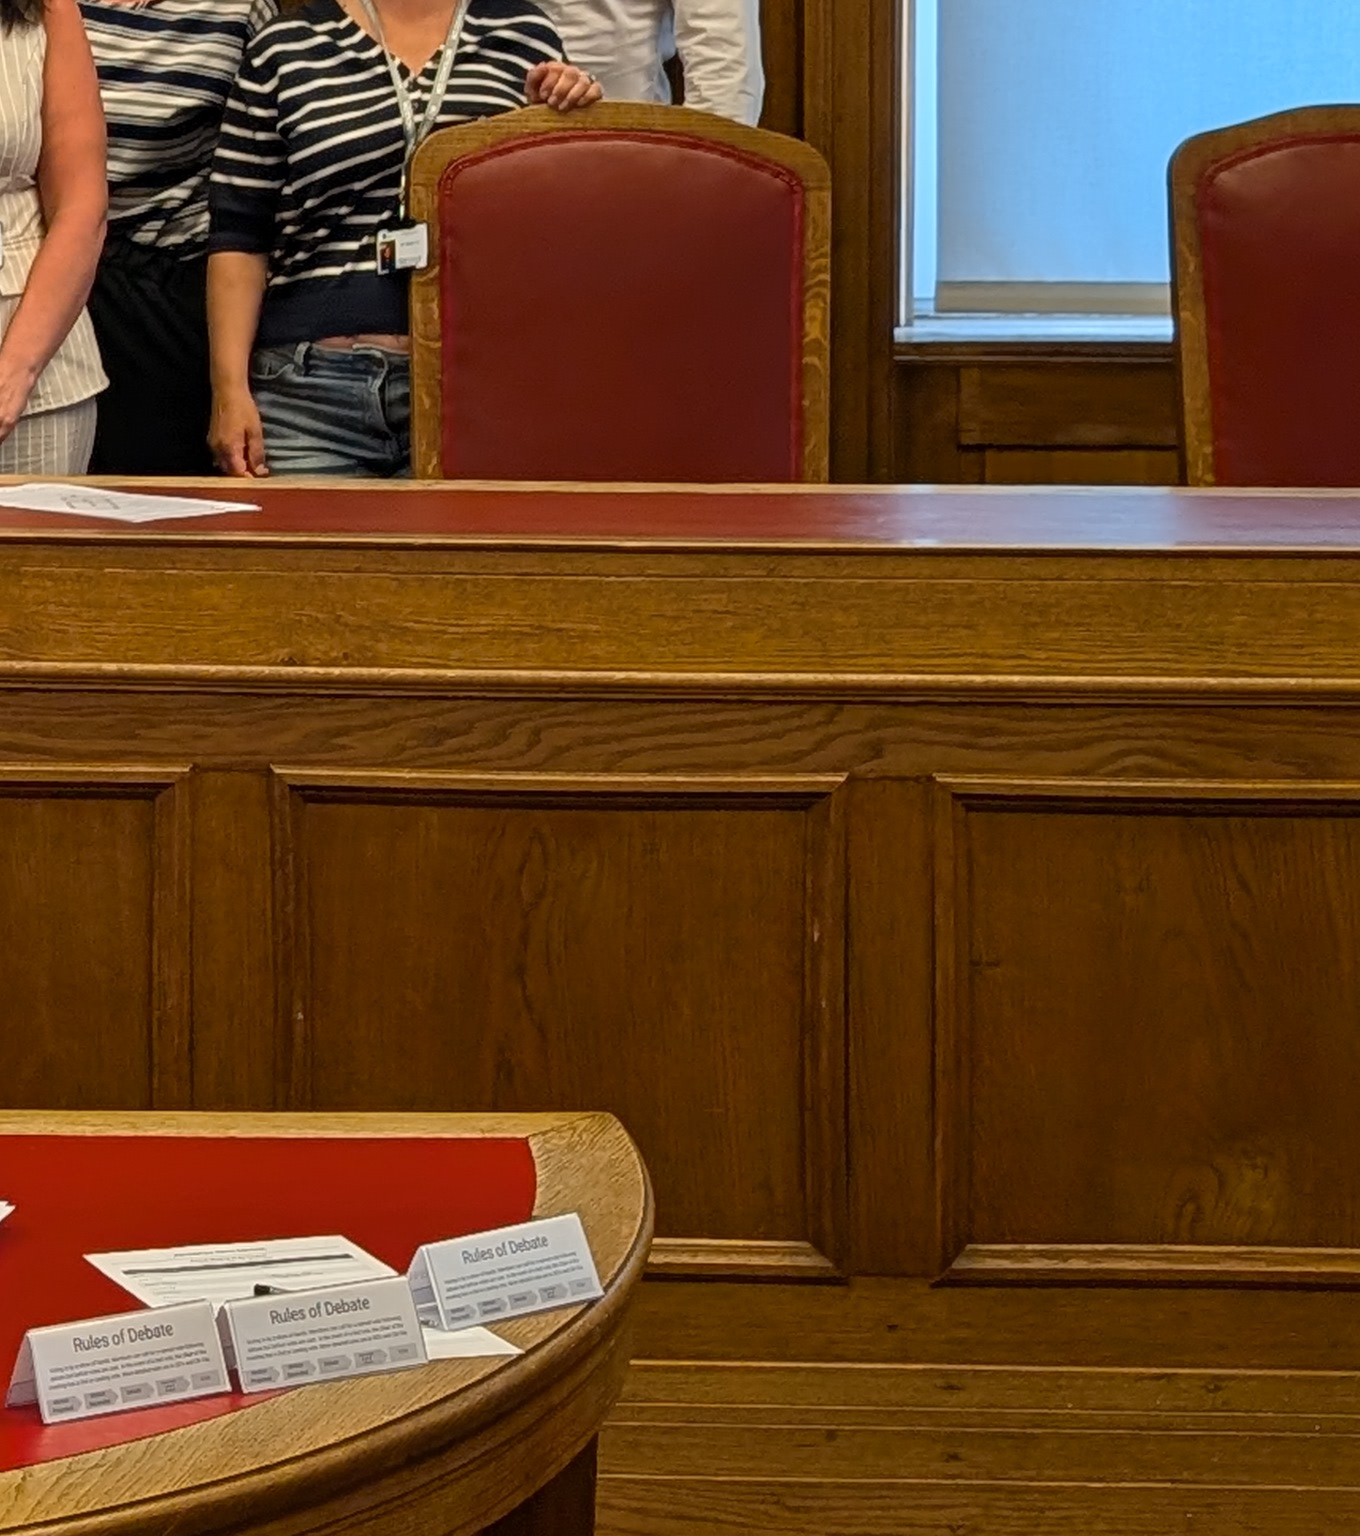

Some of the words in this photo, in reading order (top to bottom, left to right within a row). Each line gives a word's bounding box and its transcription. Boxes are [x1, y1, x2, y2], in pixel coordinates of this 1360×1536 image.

[462, 1248, 495, 1265] Rules
[495, 1242, 509, 1258] of
[509, 1234, 549, 1254] Debate
[268, 1306, 306, 1325] Rules
[309, 1301, 323, 1318] of
[324, 1297, 370, 1316] Debate
[73, 1333, 110, 1353] Rules
[111, 1327, 126, 1346] of
[127, 1323, 175, 1343] Debate
